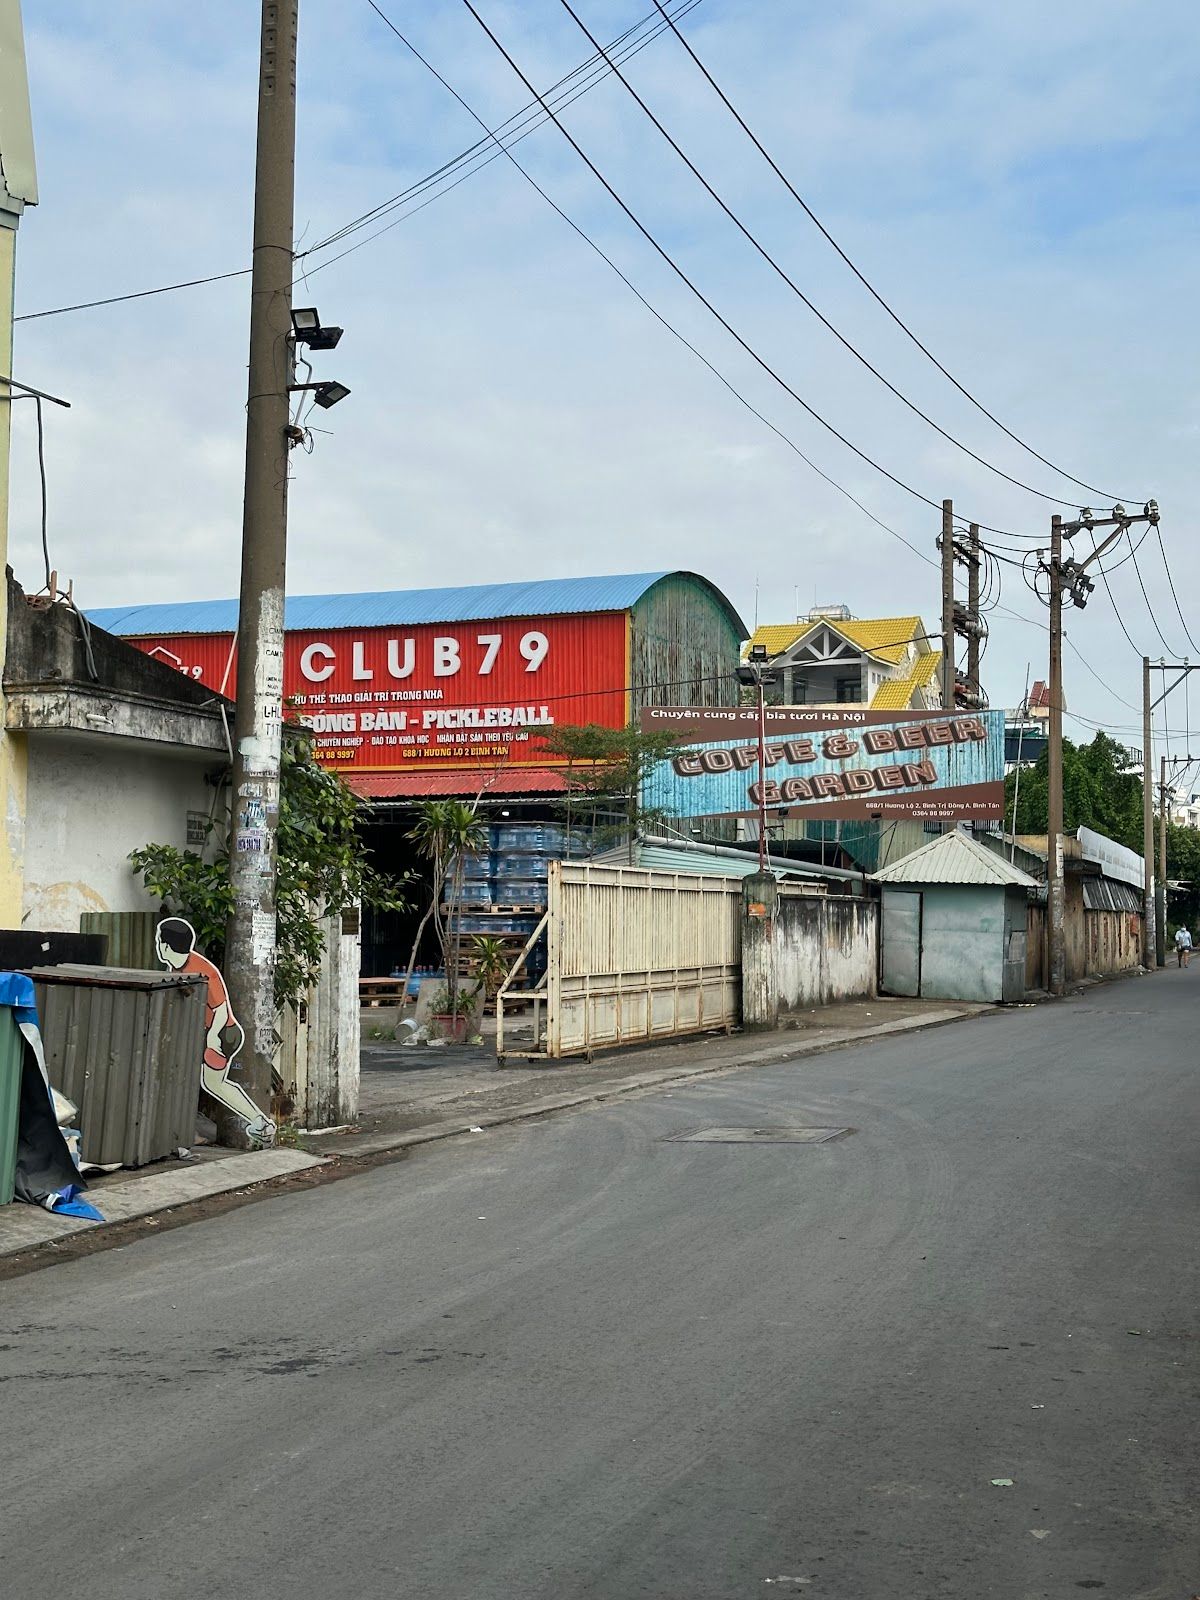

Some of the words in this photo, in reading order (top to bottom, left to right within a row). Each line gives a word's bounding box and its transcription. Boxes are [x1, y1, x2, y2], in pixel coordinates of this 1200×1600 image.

[329, 693, 352, 703] THAO
[374, 689, 389, 702] TRÍ
[391, 690, 421, 701] TRONG
[361, 707, 408, 731] BÀN
[422, 706, 555, 730] PICKLEBALL
[650, 709, 700, 719] Chuyên
[704, 711, 736, 720] cung
[766, 711, 786, 720] bia
[789, 712, 818, 720] tươi
[822, 712, 840, 721] Hà
[843, 713, 866, 722] Nội
[416, 734, 430, 746] HỌC
[484, 732, 501, 742] THEO
[464, 747, 471, 755] 2
[674, 740, 816, 776] COFFE
[823, 733, 859, 759] &
[863, 717, 987, 755] BEER
[749, 761, 937, 804] GARDEN
